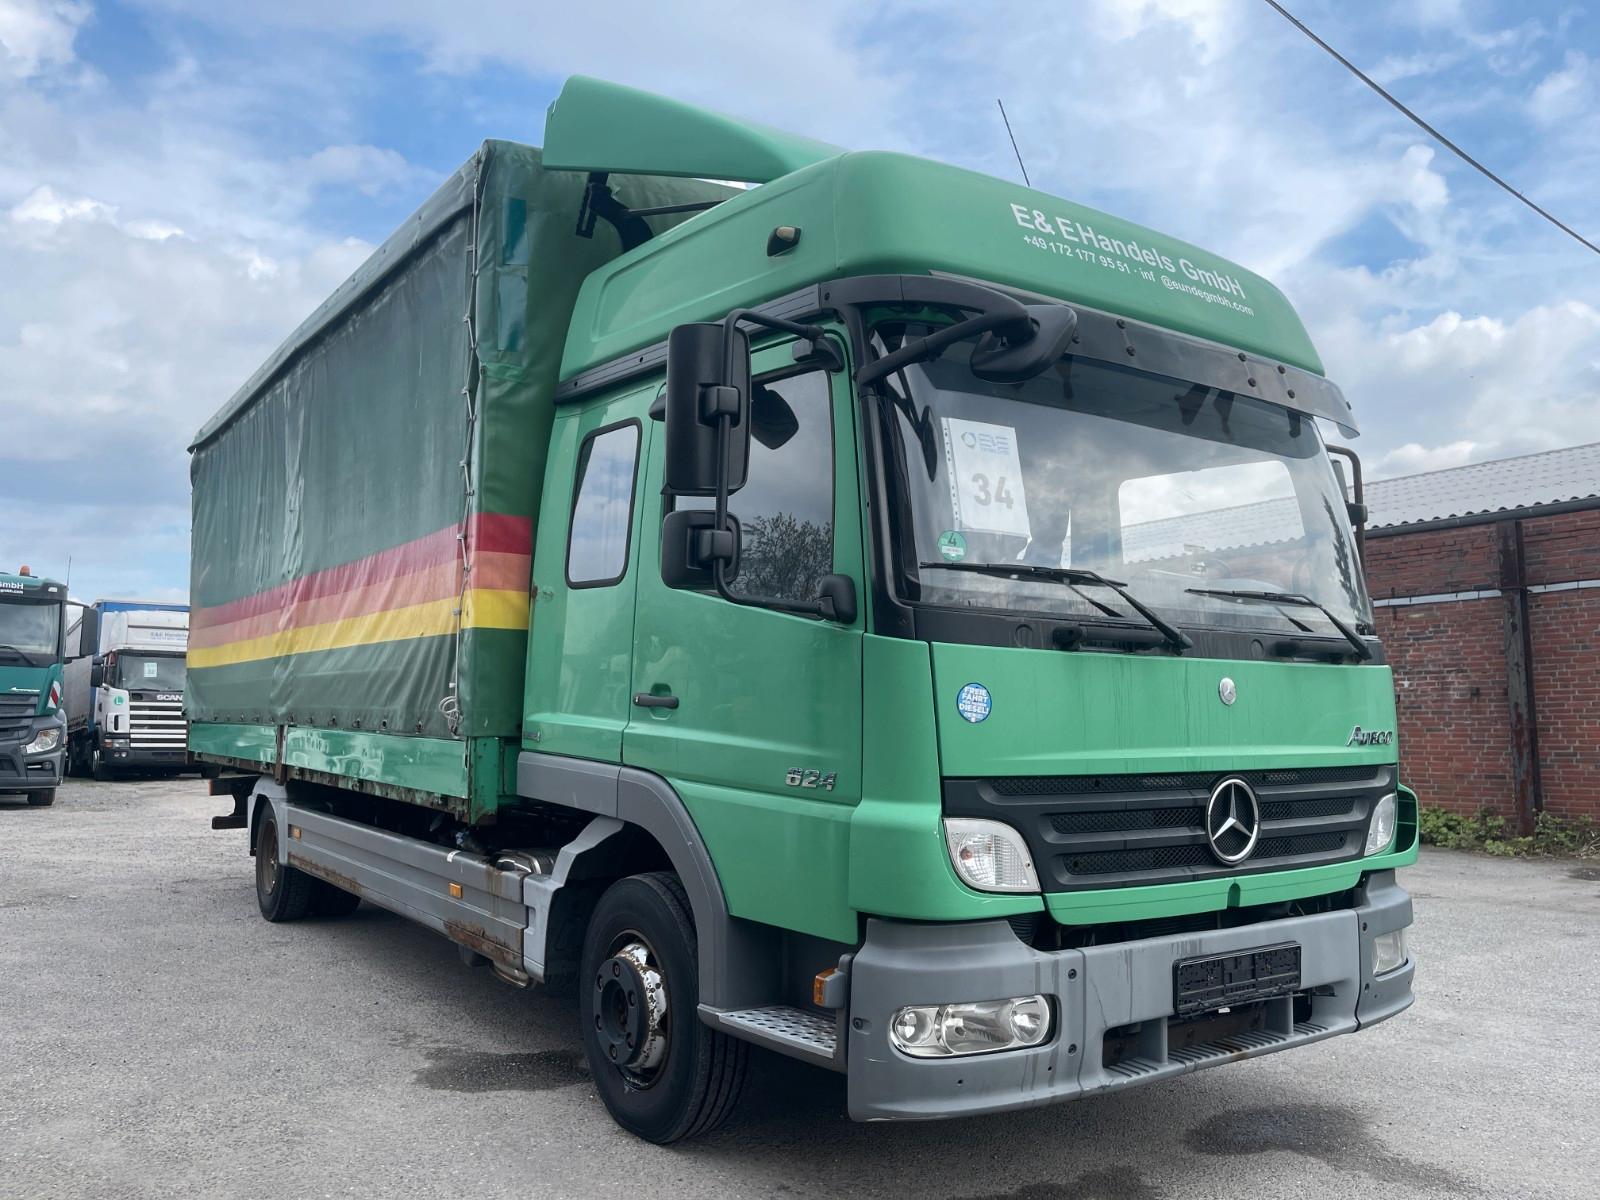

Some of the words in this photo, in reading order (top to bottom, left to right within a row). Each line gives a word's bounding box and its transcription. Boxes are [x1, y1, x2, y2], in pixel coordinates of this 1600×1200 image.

[1023, 235, 1048, 250] +49
[1049, 242, 1074, 257] 172
[1075, 248, 1096, 264] 177
[1099, 255, 1115, 269] 95
[1116, 260, 1131, 274] 51
[1179, 258, 1246, 299] GmbH
[971, 473, 1014, 510] 34
[947, 532, 957, 547] 4
[785, 767, 837, 792] 624
